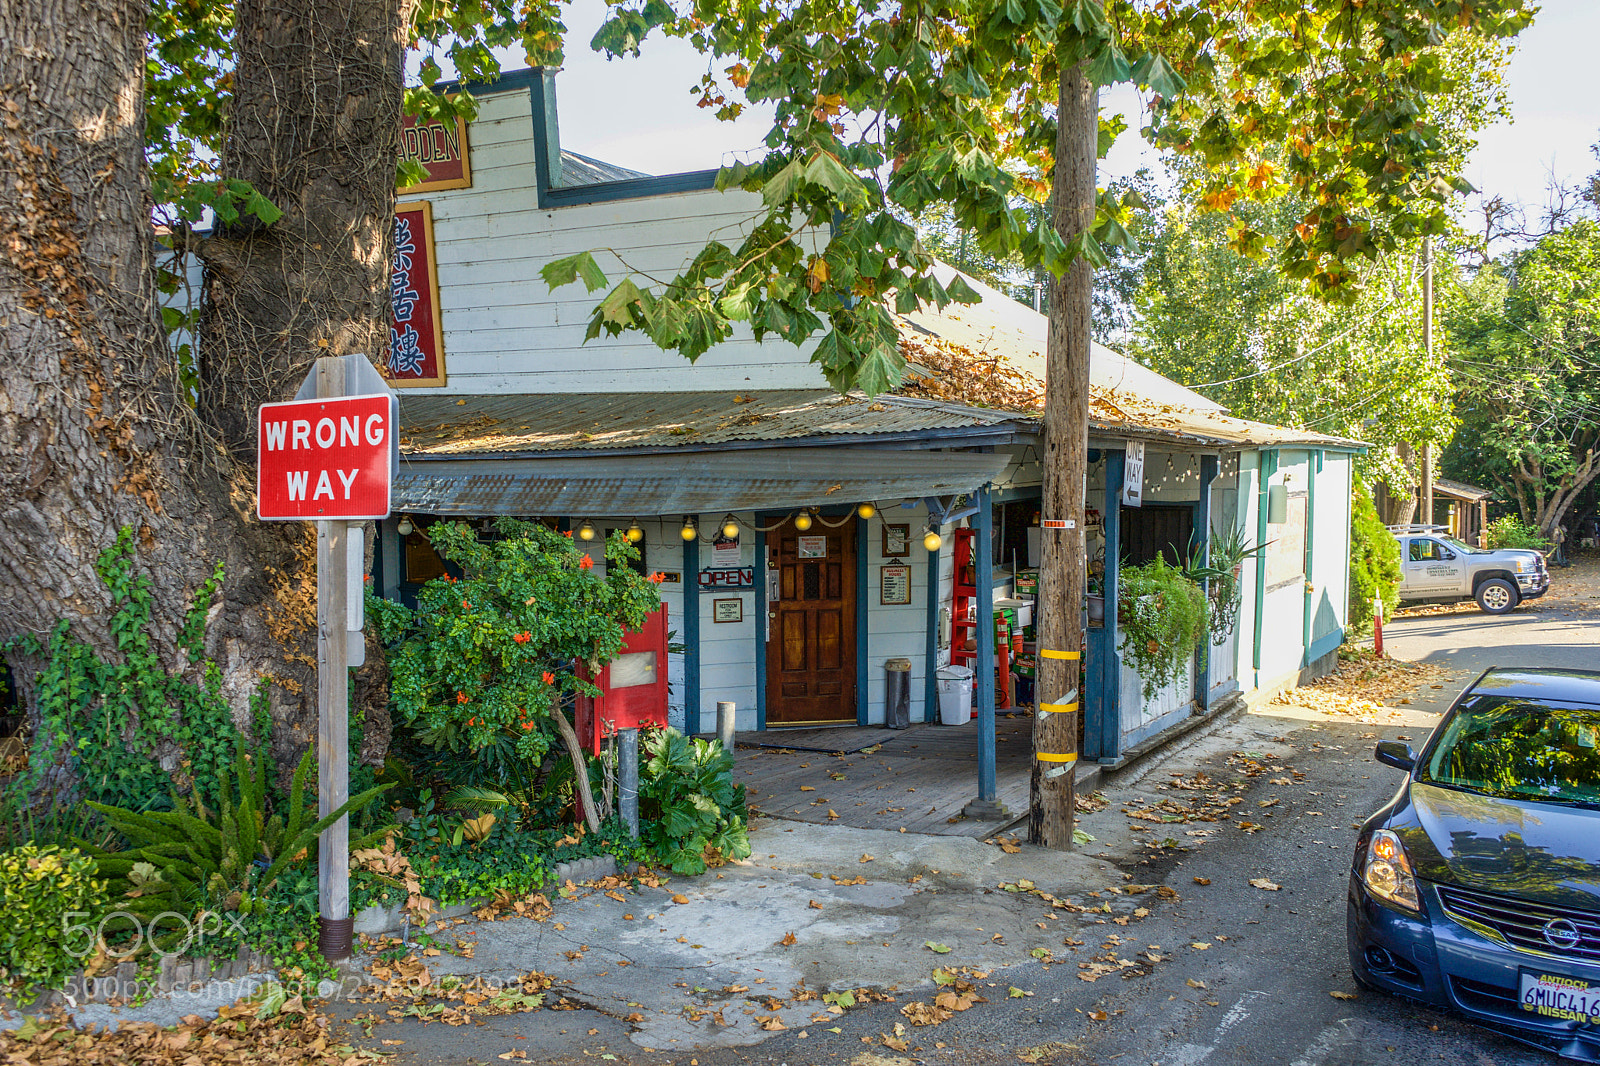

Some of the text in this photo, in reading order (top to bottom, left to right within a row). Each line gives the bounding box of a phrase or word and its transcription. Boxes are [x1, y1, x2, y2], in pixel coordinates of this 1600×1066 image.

[265, 413, 384, 451] WRONG
[1127, 440, 1143, 461] ONE
[1126, 462, 1142, 484] WAY
[287, 469, 359, 501] WAY
[698, 570, 752, 585] OPEN
[1540, 974, 1588, 989] ANTIOCH
[1525, 987, 1600, 1016] 6MUC416
[1537, 1005, 1586, 1023] NISSAN
